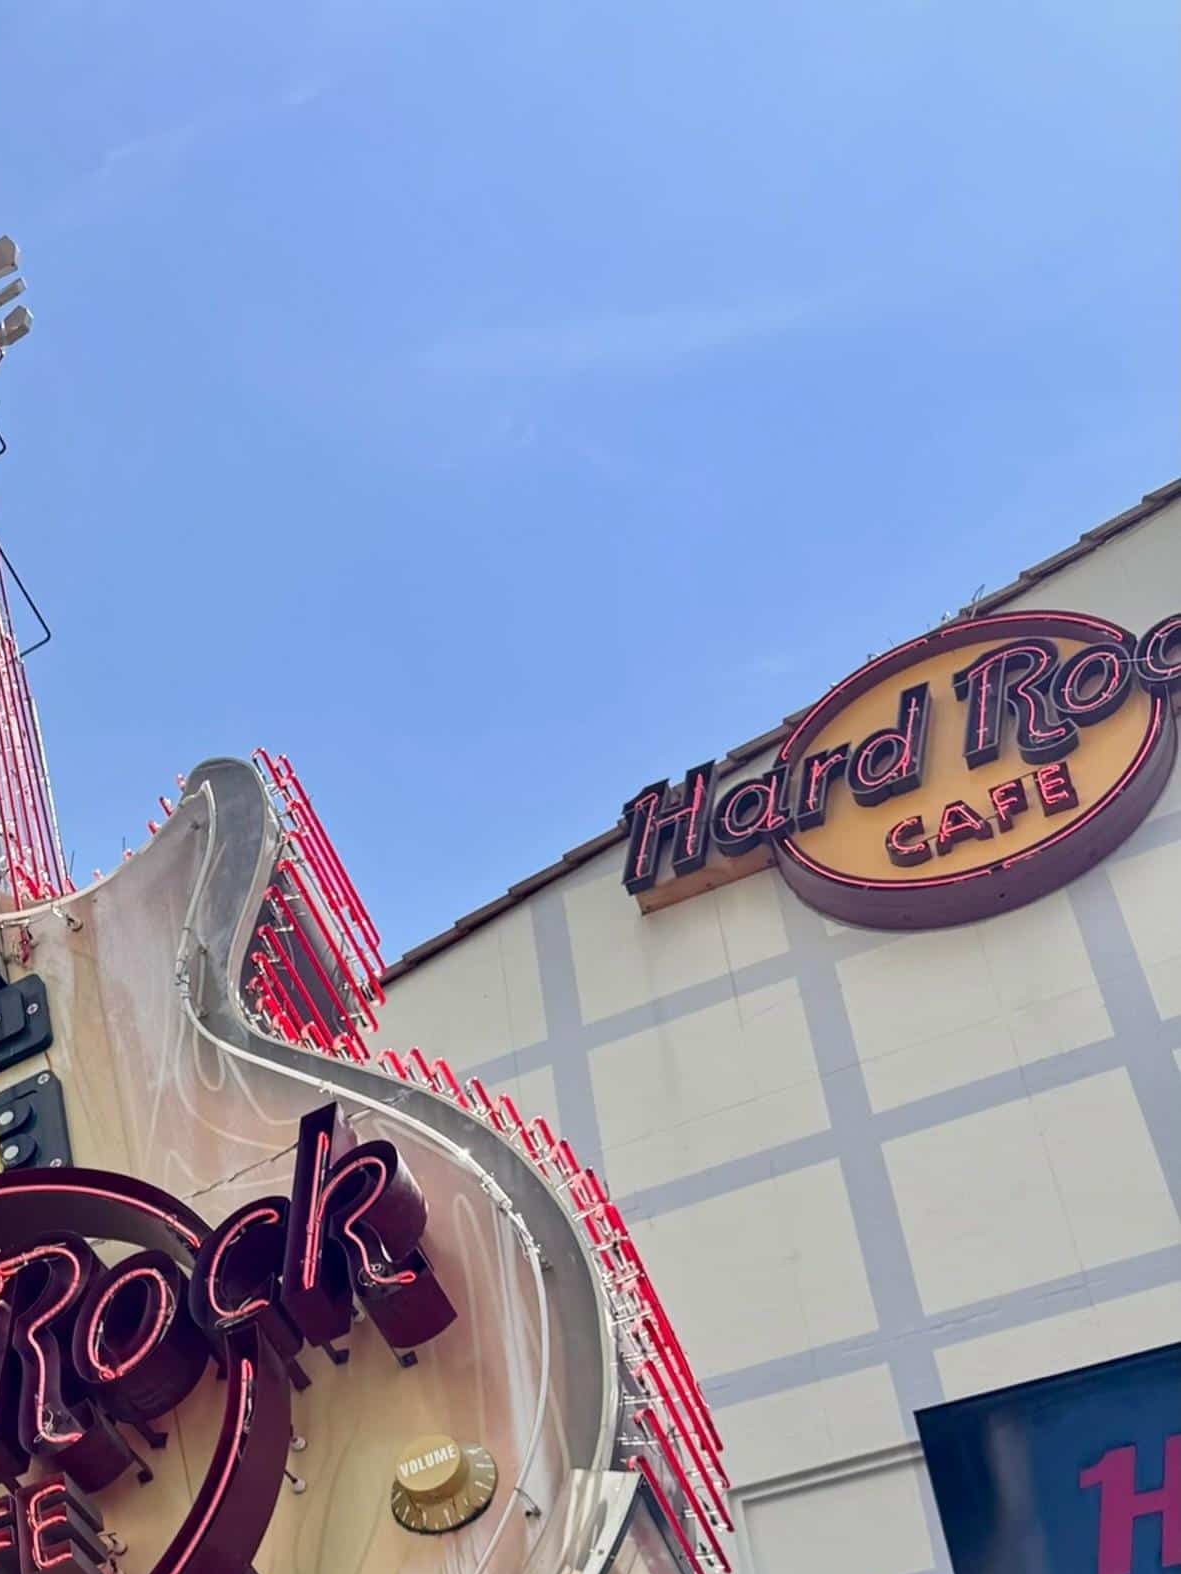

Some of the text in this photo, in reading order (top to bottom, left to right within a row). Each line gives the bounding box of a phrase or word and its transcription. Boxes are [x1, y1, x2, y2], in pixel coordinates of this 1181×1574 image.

[622, 681, 932, 895] Hard
[884, 760, 1080, 868] CAFE
[398, 1444, 458, 1478] VOLUME
